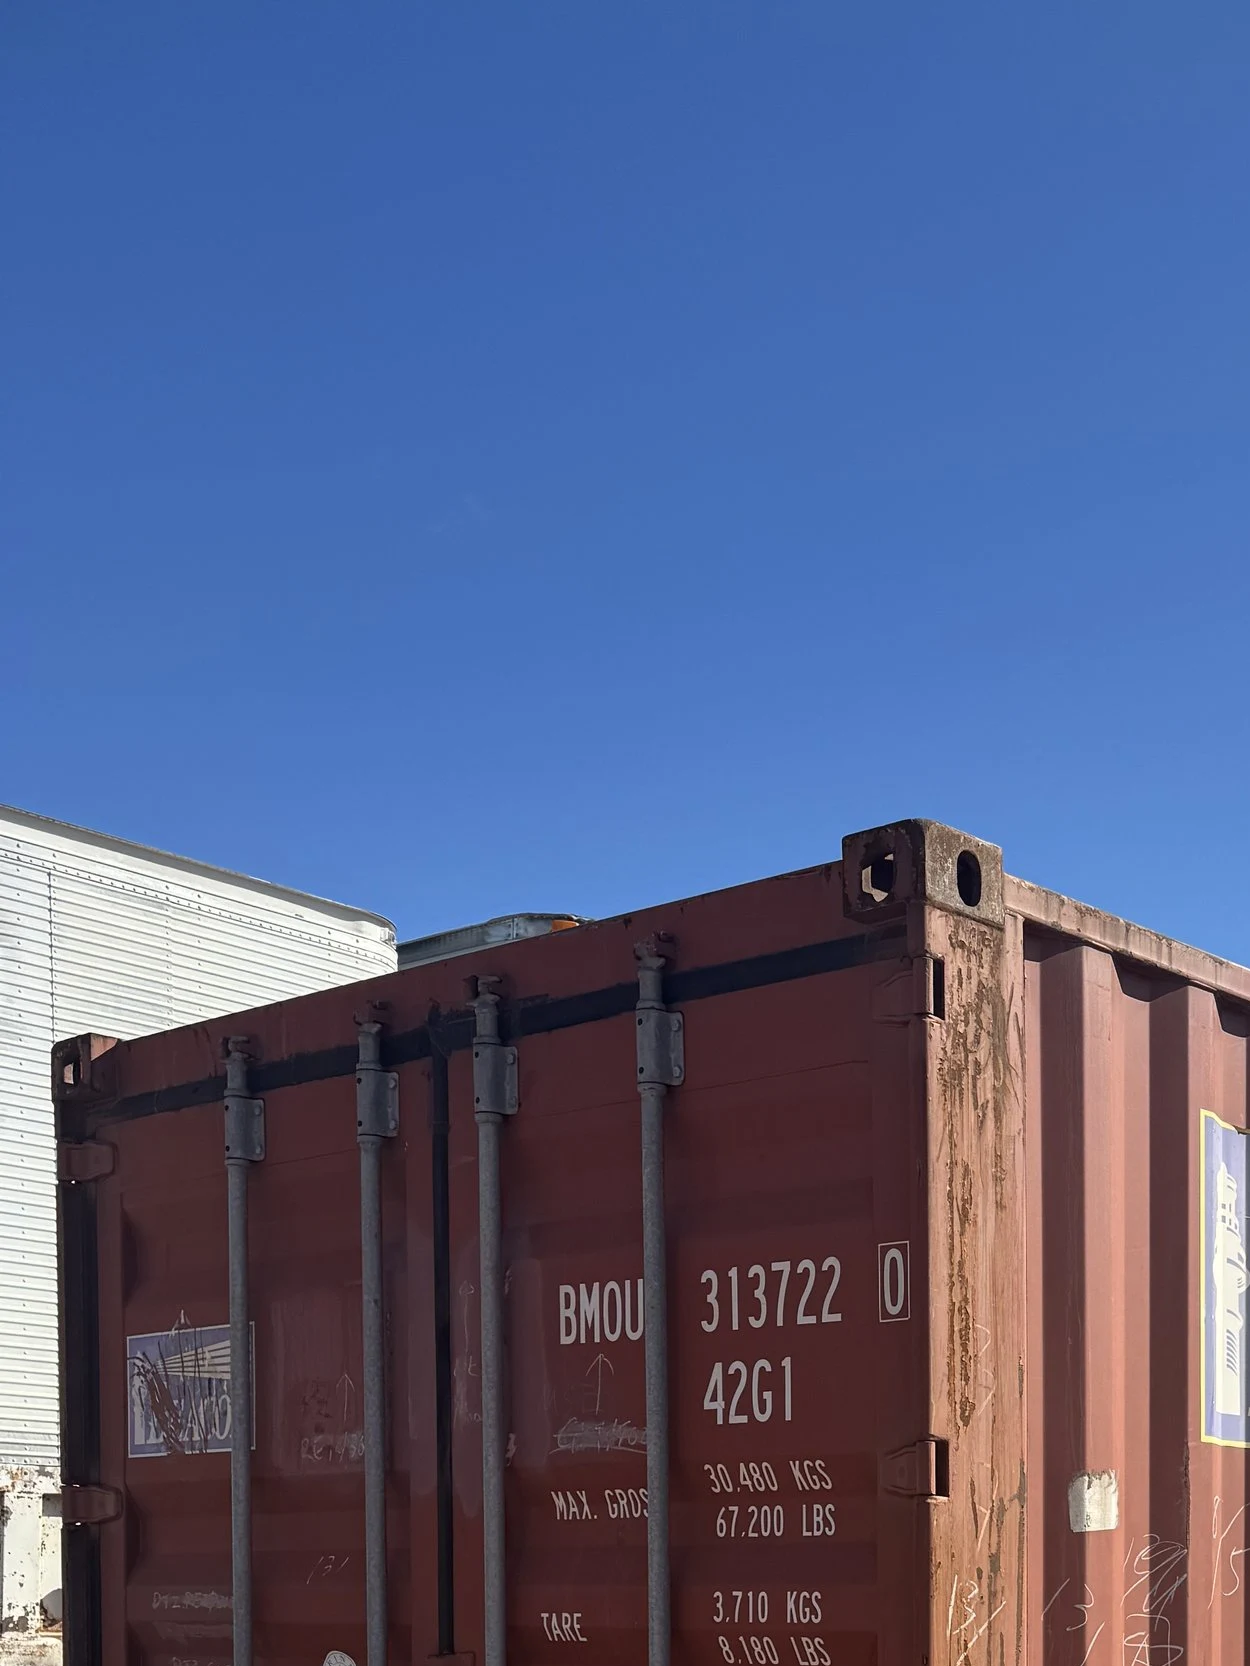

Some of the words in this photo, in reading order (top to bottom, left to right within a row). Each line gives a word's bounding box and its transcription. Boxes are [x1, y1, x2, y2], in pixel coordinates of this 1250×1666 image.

[559, 1278, 644, 1345] BMOU
[700, 1255, 843, 1333] 313722
[883, 1247, 906, 1316] 0
[703, 1356, 793, 1425] 42G1
[789, 1459, 833, 1491] KGS
[551, 1490, 598, 1520] MAX.
[802, 1503, 836, 1537] LBS
[713, 1591, 769, 1623] 3,710
[787, 1590, 822, 1624] KGS
[541, 1612, 588, 1643] TARE
[790, 1636, 832, 1666] LBS
